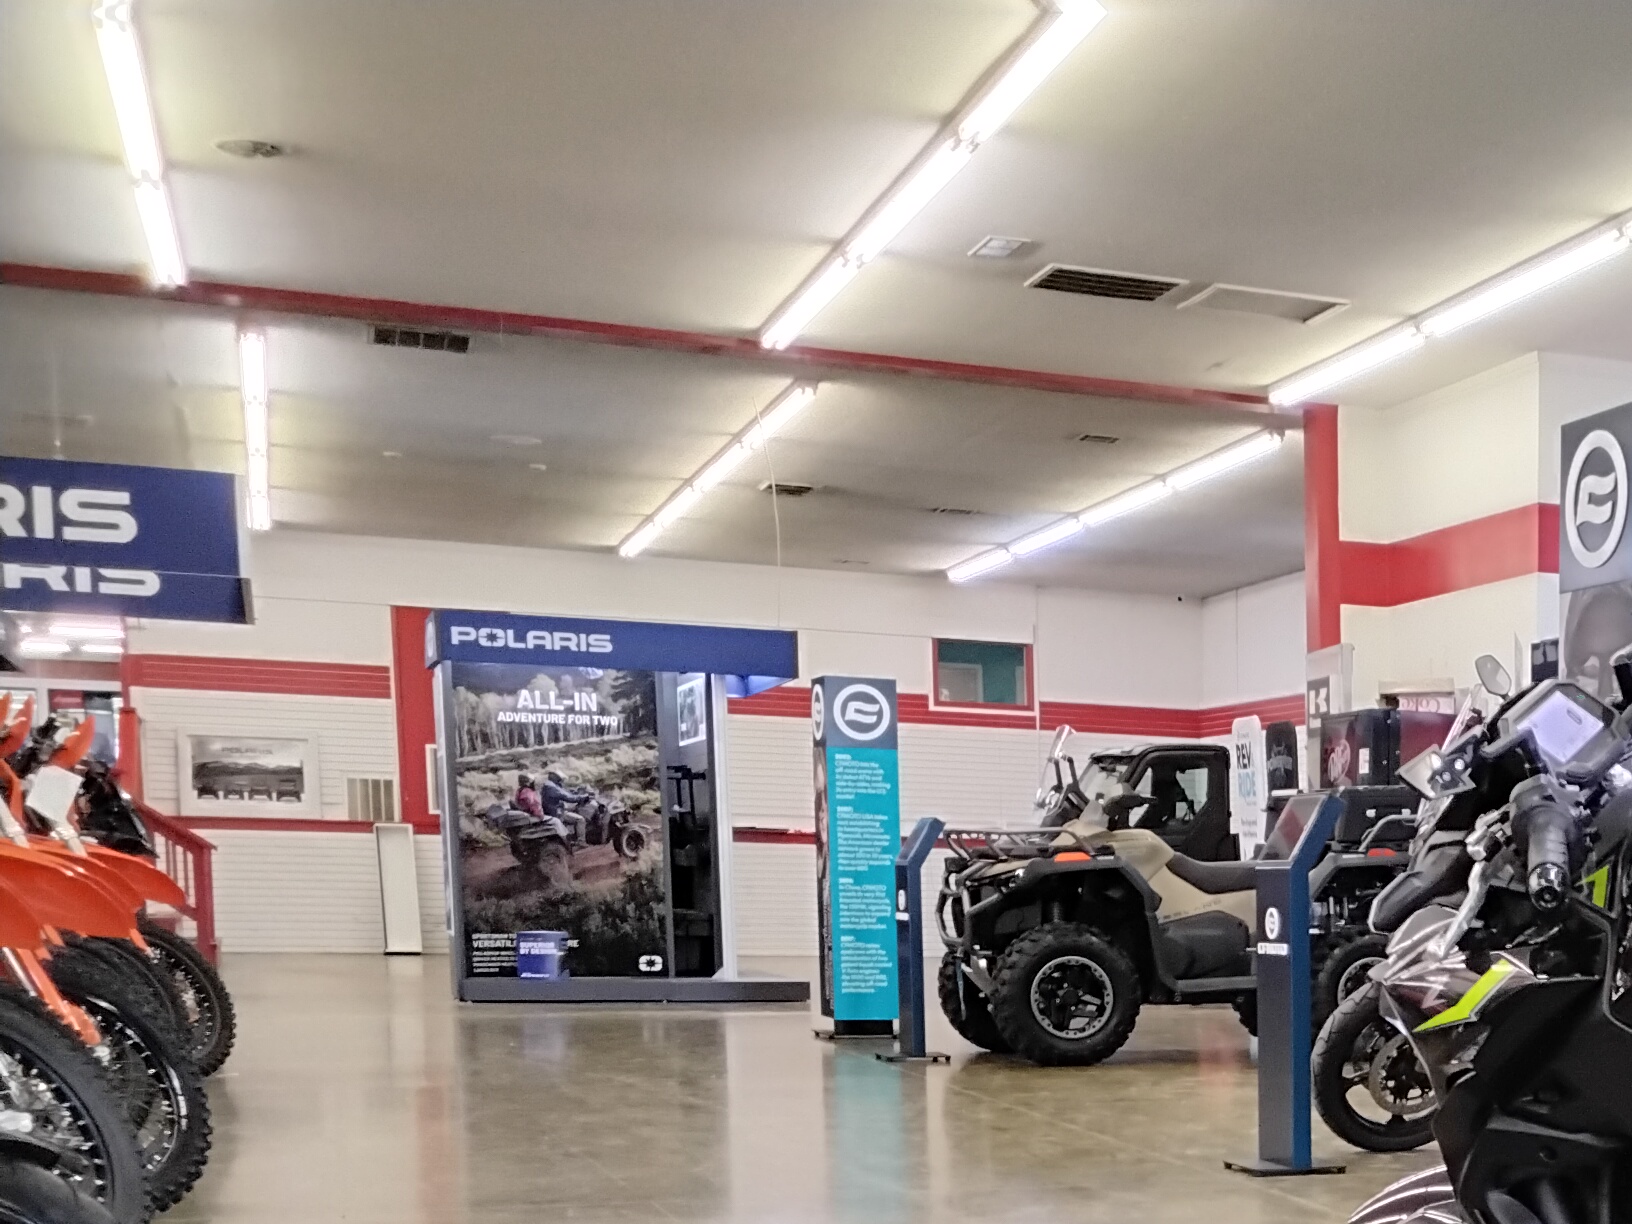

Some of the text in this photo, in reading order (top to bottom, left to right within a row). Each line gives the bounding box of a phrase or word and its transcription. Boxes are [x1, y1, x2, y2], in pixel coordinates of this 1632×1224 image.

[450, 625, 613, 653] POLARIS
[517, 688, 598, 712] ALL-IN
[497, 711, 619, 727] ADVENTURE FOR TWO
